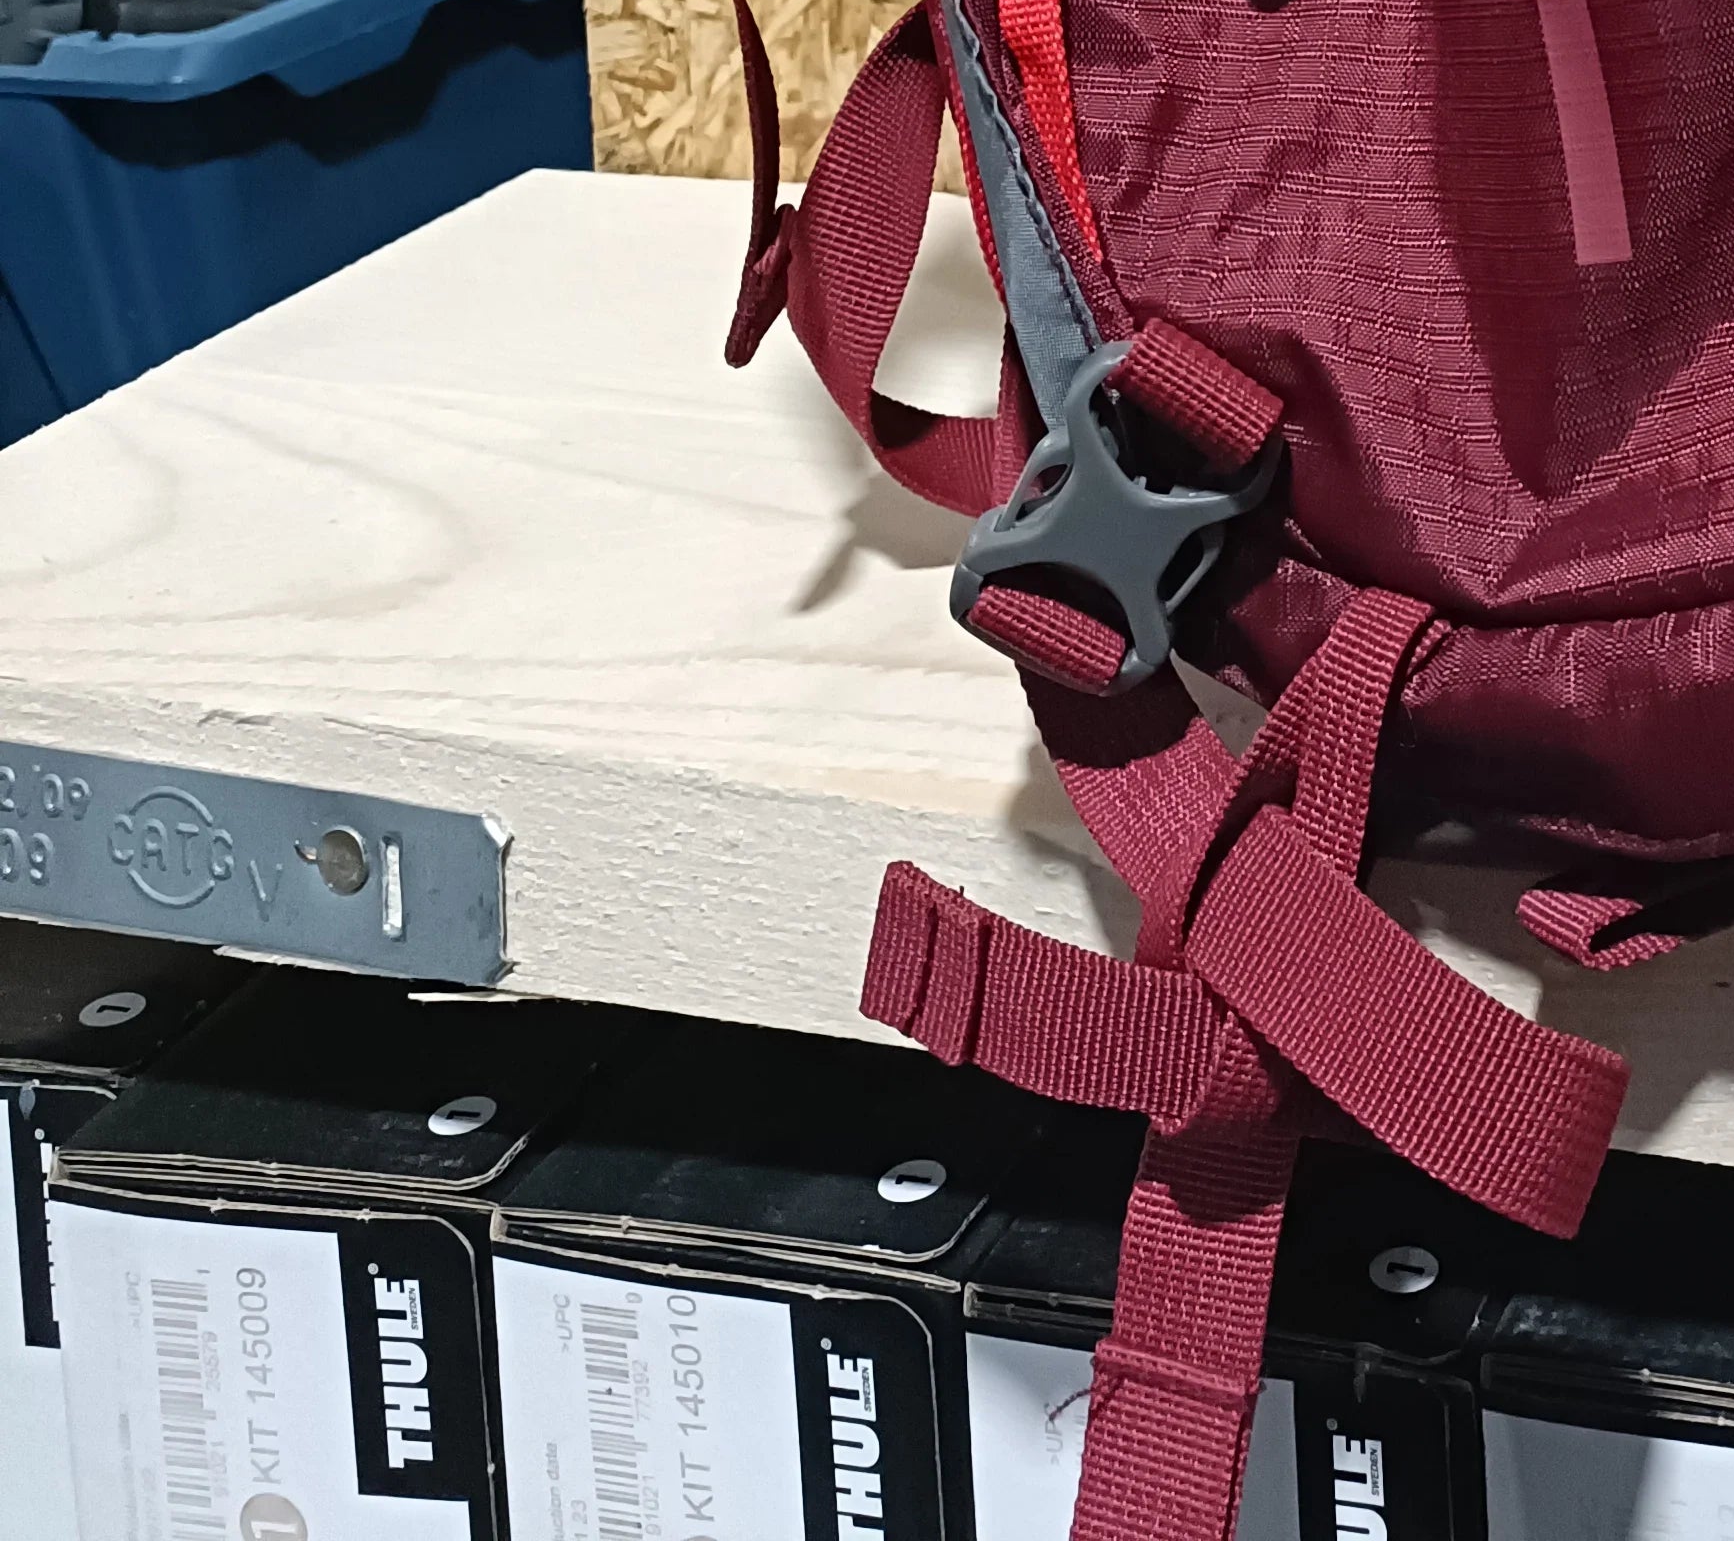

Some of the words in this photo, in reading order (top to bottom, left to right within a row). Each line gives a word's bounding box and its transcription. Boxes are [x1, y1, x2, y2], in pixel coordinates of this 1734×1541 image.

[236, 1267, 277, 1403] 145009
[408, 1287, 419, 1331] SWEDEN
[373, 1277, 434, 1469] THULE
[667, 1294, 708, 1437] 145010
[861, 1366, 873, 1413] SWEDEN
[246, 1419, 282, 1485] KIT
[679, 1451, 715, 1522] KIT
[826, 1353, 886, 1541] THULE
[1332, 1434, 1388, 1541] ULE
[1369, 1446, 1381, 1497] SWEDEN
